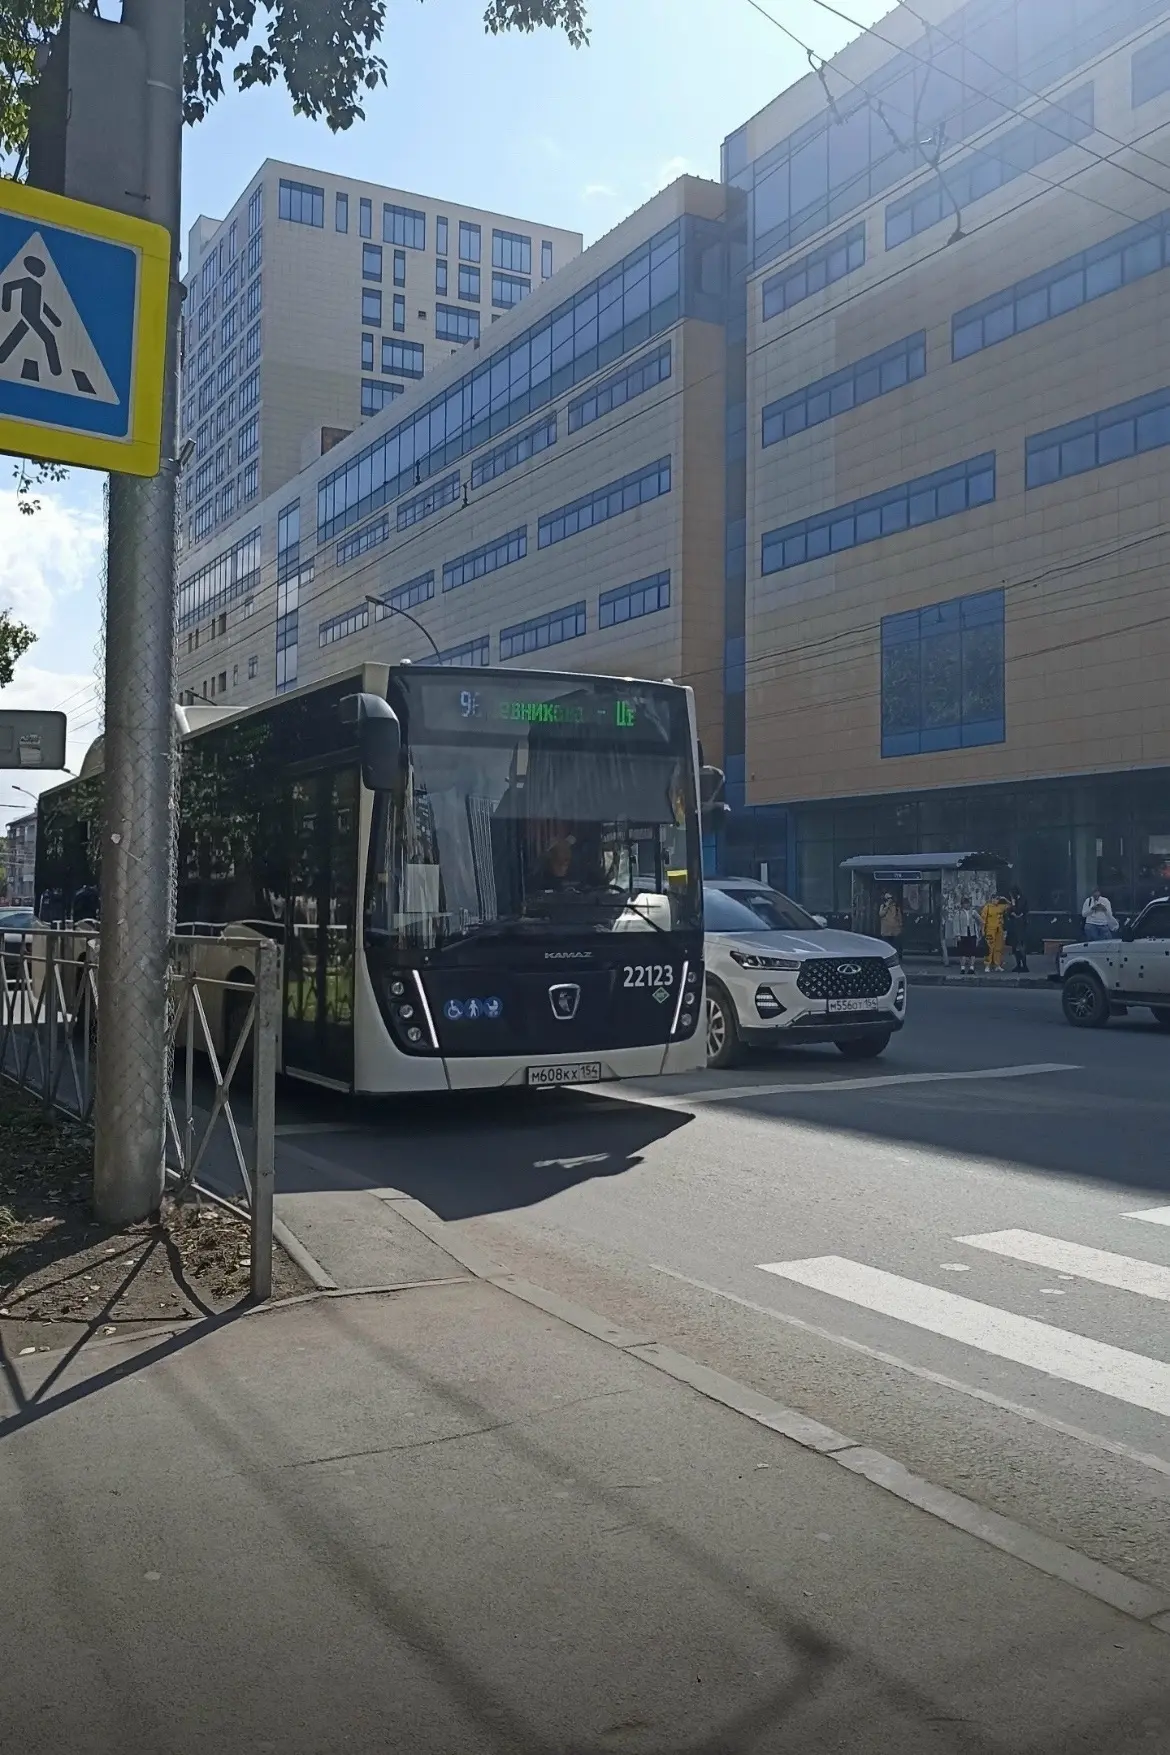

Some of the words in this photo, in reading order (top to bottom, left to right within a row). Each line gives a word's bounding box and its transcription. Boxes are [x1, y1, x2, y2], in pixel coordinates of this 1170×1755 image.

[623, 965, 674, 987] 22123
[531, 1068, 578, 1083] М608КХ
[580, 1065, 598, 1076] 154
